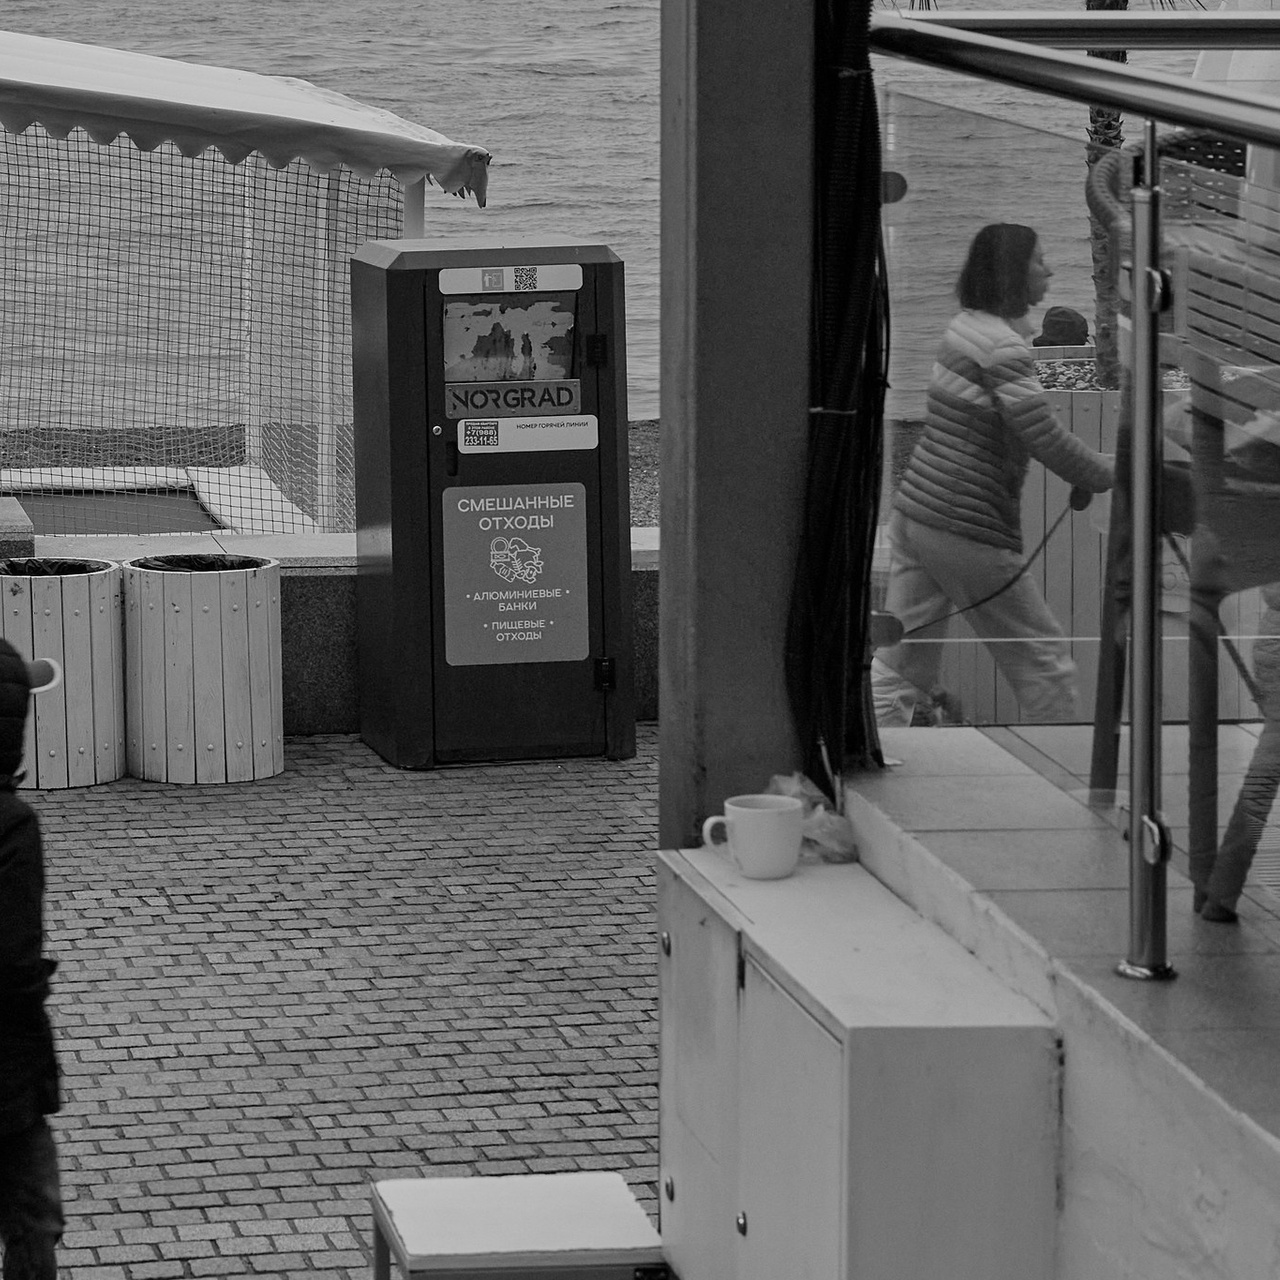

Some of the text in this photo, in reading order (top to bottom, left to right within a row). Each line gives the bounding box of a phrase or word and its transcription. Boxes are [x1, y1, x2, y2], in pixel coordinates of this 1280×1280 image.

[452, 387, 573, 410] NORGRAD
[465, 436, 498, 445] 233-11-65
[458, 495, 574, 512] СМЕШАННЫЕ
[479, 515, 554, 530] ОТХОДЫ
[473, 589, 562, 601] АЛЮМИНИЕВЫЕ
[498, 601, 537, 611] БАНКИ
[492, 620, 546, 630] ПИЩЕВЫЕ
[496, 631, 542, 641] ОТХОДЫ
